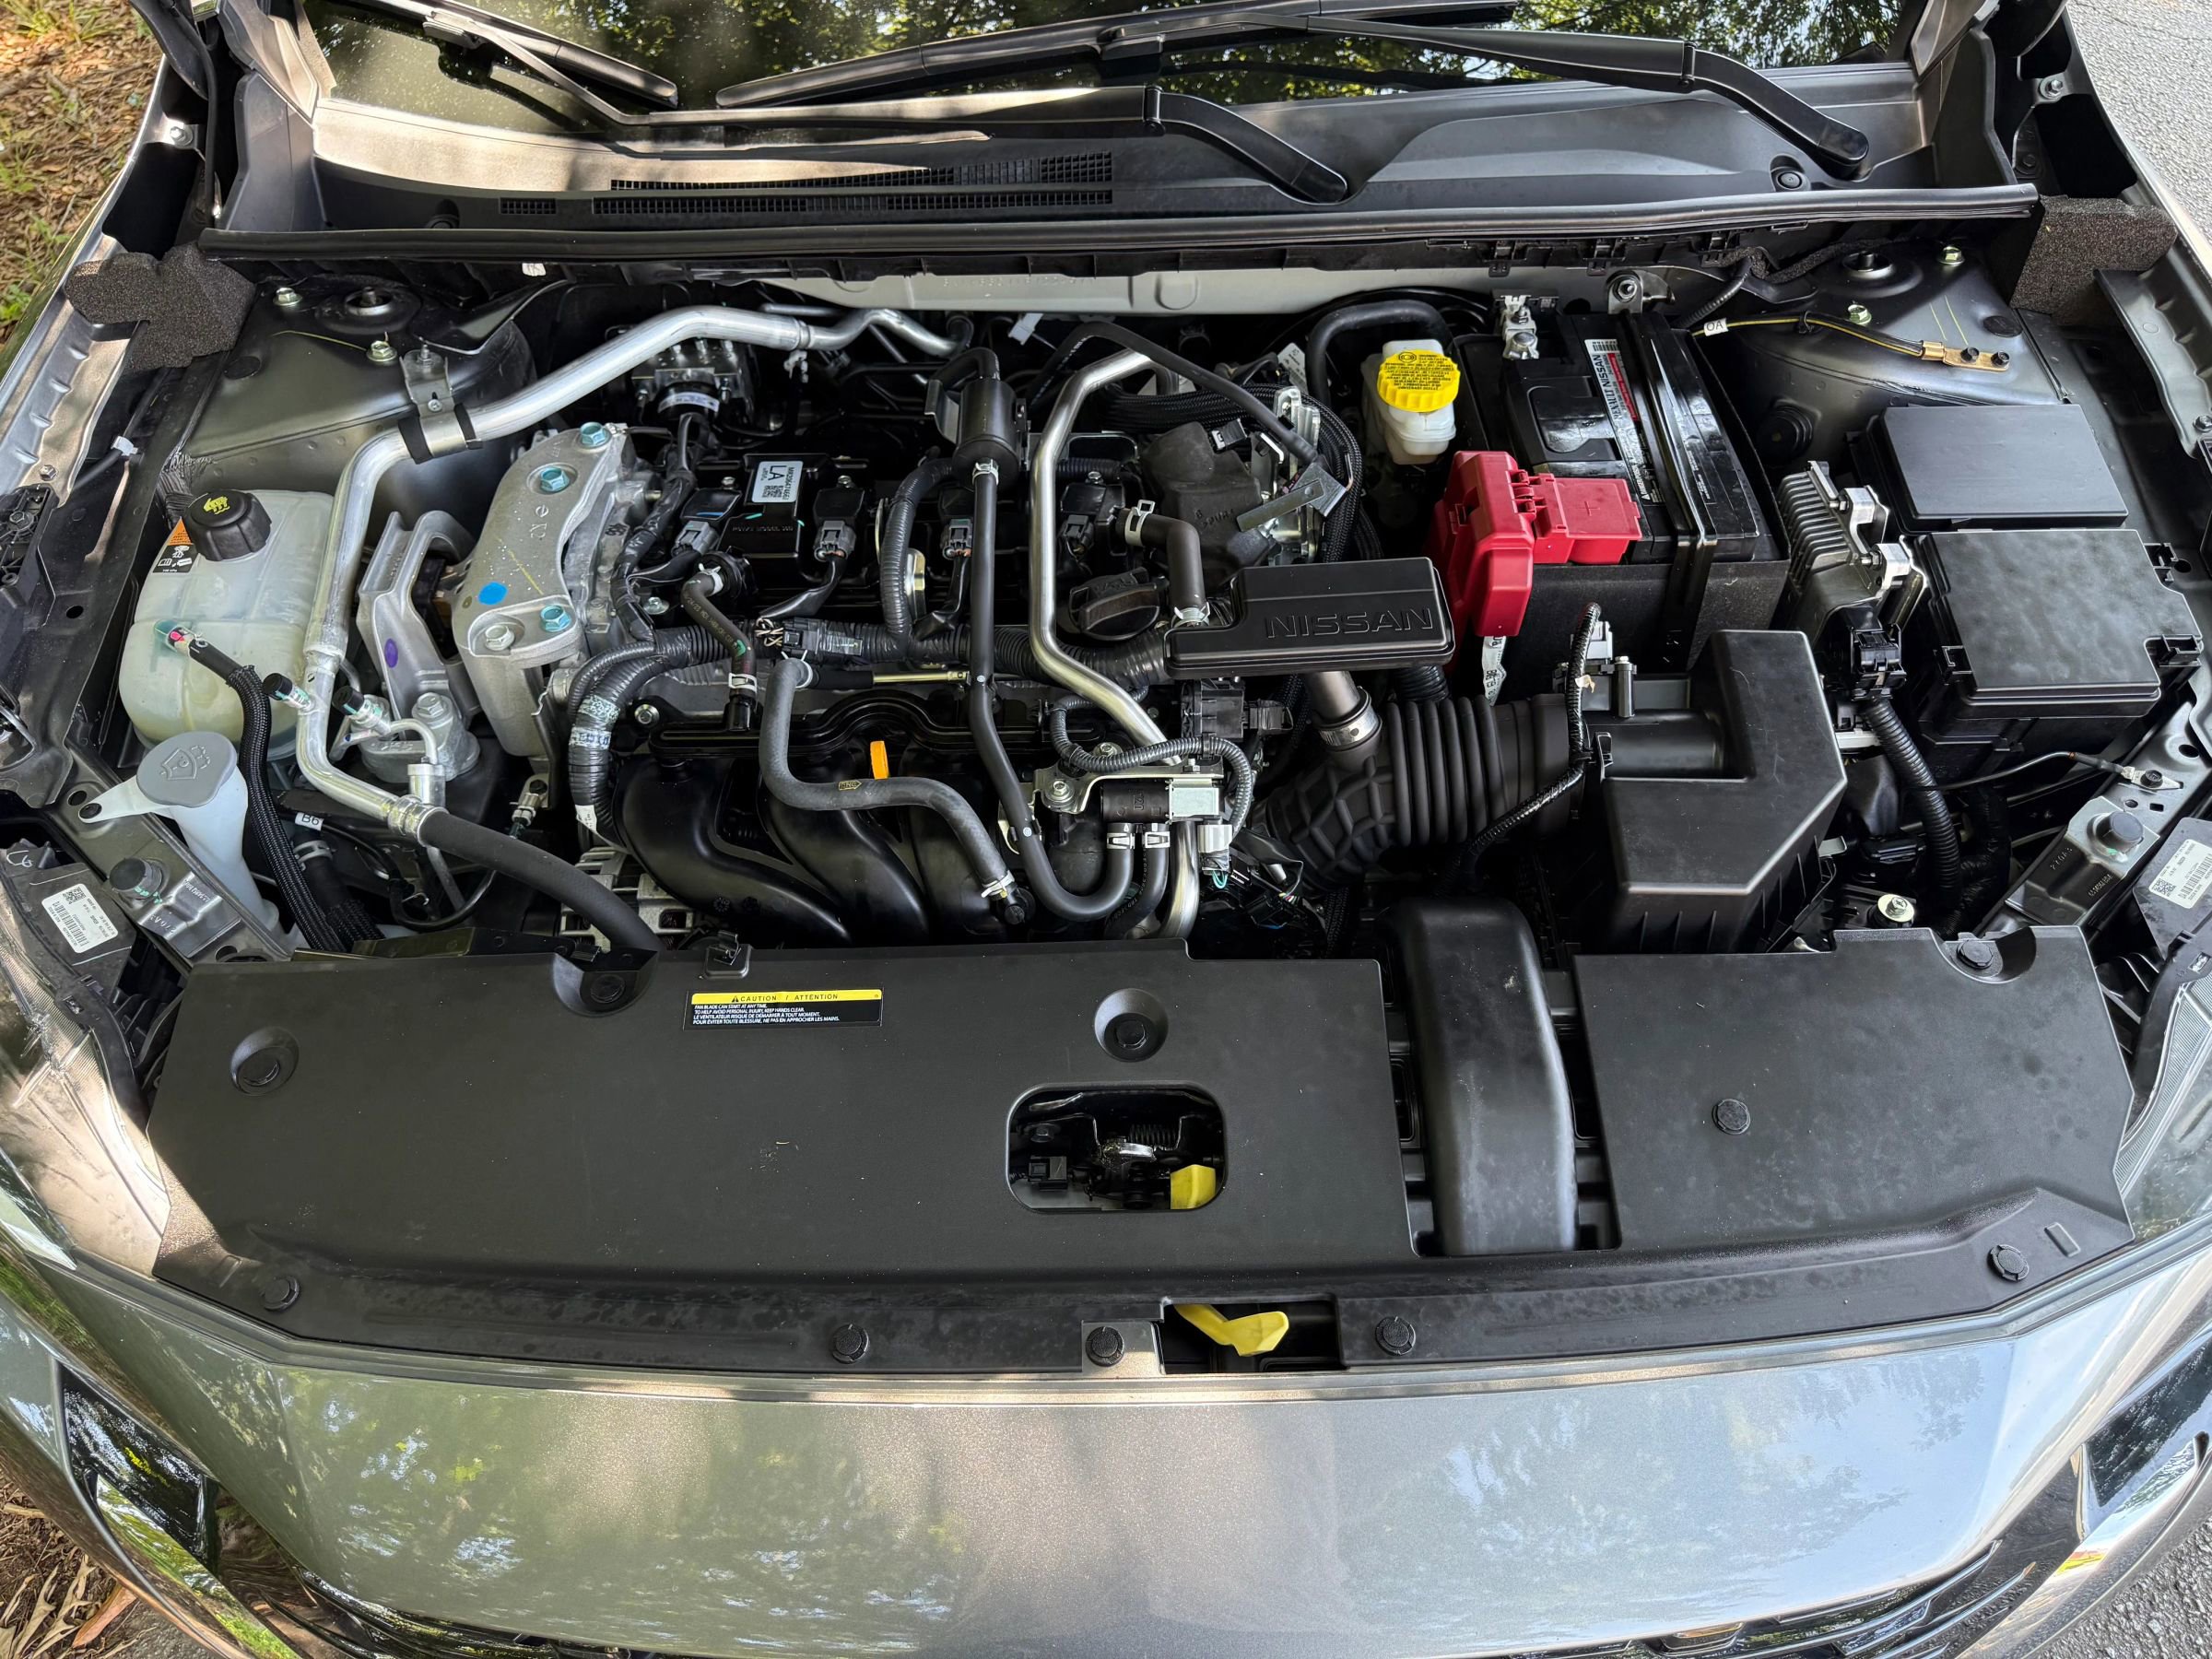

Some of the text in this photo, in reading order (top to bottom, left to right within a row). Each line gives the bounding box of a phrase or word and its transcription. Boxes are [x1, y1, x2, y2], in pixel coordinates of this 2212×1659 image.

[1592, 354, 1610, 388] NISSAN
[768, 465, 787, 480] LA
[1265, 607, 1434, 639] NISSAN
